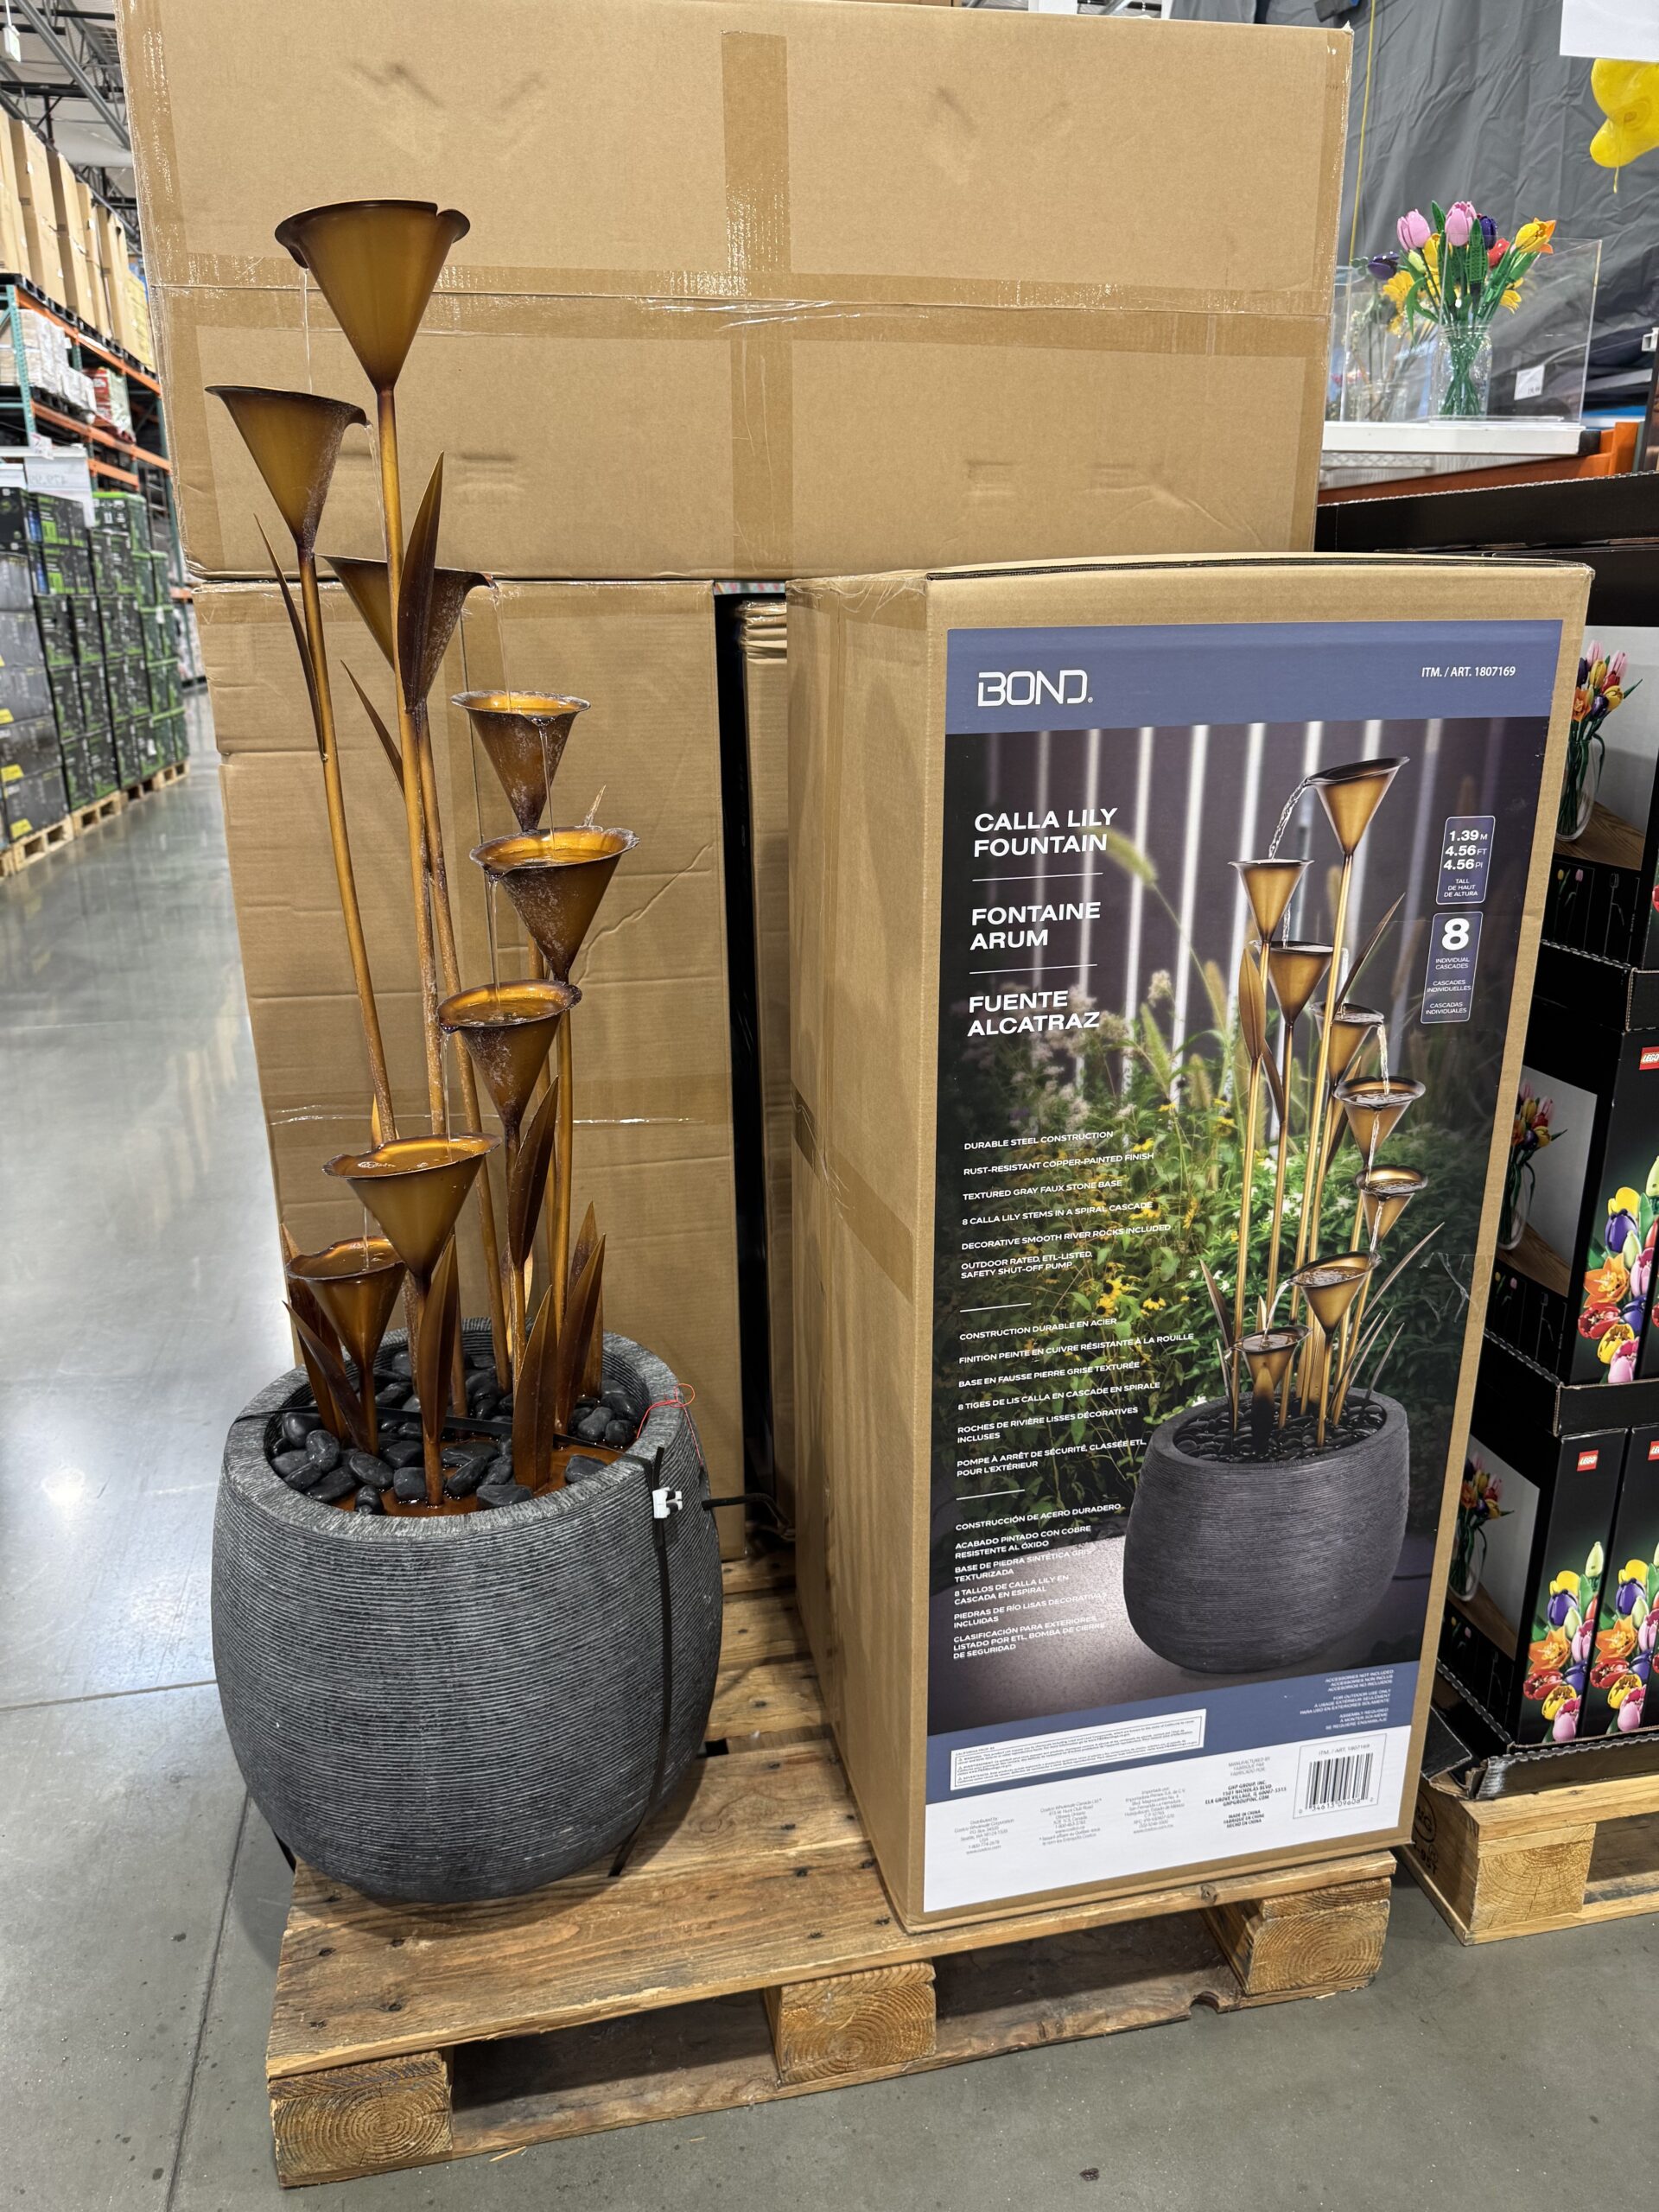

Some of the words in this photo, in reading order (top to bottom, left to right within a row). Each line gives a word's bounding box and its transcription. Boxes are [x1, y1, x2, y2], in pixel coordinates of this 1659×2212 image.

[1421, 667, 1442, 677] ITM.
[1444, 666, 1449, 677] /
[1450, 666, 1471, 677] ART.
[1475, 666, 1516, 677] 1807169
[974, 810, 1059, 832] CALLA
[1067, 807, 1118, 828] LILY
[974, 834, 1107, 858] FOUNTAIN
[1449, 830, 1478, 842] 1.39
[1445, 845, 1476, 856] 4.56
[1443, 859, 1474, 870] 4.56
[971, 901, 1101, 926] FONTAINE
[969, 929, 1048, 950] ARUM
[1441, 918, 1470, 950] 8
[969, 990, 1069, 1014] FUENTE
[967, 1011, 1100, 1037] ALCATRAZ
[964, 1140, 1009, 1150] DURABLE
[1010, 1137, 1039, 1147] STEEL
[1040, 1131, 1114, 1144] CONSTRUCTION
[963, 1162, 1041, 1176] RUST-RESISTANT
[1043, 1155, 1122, 1169] COPPER-PAINTED
[1124, 1153, 1154, 1162] FINISH
[963, 1190, 1011, 1201] TEXTURED
[1013, 1187, 1039, 1196] GRAY
[1039, 1185, 1065, 1194] FAUX
[1065, 1182, 1096, 1192] STONE
[1098, 1179, 1122, 1189] BASE
[969, 1215, 1001, 1225] CALLA
[1001, 1213, 1020, 1222] LILY
[1021, 1211, 1053, 1220] STEMS
[1074, 1206, 1108, 1216] SPIRAL
[1109, 1202, 1153, 1212] CASCADE
[962, 1237, 1020, 1249] DECORATIVE
[1021, 1234, 1062, 1244] SMOOTH
[1064, 1230, 1090, 1240] RIVER
[1092, 1228, 1124, 1237] ROCKS
[1126, 1224, 1171, 1235] INCLUDED
[961, 1258, 1008, 1270] OUTDOOR
[1009, 1255, 1040, 1266] RATED,
[961, 1268, 995, 1279] SAFETY
[997, 1264, 1044, 1275] SHUT-OFF
[1045, 1261, 1072, 1270] PUMP
[959, 1326, 1031, 1340] CONSTRUCTION
[1032, 1322, 1075, 1333] DURABLE
[1077, 1320, 1089, 1329] EN
[1090, 1318, 1116, 1327] ACIER
[959, 1353, 997, 1363] FINITION
[999, 1350, 1030, 1360] PEINTE
[1032, 1348, 1044, 1357] EN
[1046, 1344, 1078, 1355] CUIVRE
[1080, 1339, 1133, 1351] RÉSISTANTE
[1134, 1337, 1141, 1346] À
[1156, 1332, 1194, 1344] ROUILLE
[958, 1378, 982, 1388] BASE
[983, 1376, 996, 1385] EN
[998, 1373, 1032, 1383] FAUSSE
[1033, 1370, 1065, 1380] PIERRE
[1066, 1366, 1093, 1376] GRISE
[1094, 1361, 1140, 1373] TEXTURÉE
[964, 1400, 990, 1409] TIGES
[992, 1398, 1005, 1407] DE
[1006, 1396, 1020, 1405] LIS
[1020, 1393, 1051, 1403] CALLA
[1065, 1387, 1109, 1398] CASCADE
[1123, 1382, 1160, 1392] SPIRALE
[957, 1422, 995, 1433] ROCHES
[996, 1421, 1009, 1429] DE
[1010, 1416, 1045, 1427] RIVIÈRE
[1046, 1414, 1076, 1423] LISSES
[1077, 1406, 1138, 1420] DÉCORATIVES
[957, 1432, 1001, 1443] INCLUSES
[957, 1457, 989, 1467] POMPE
[991, 1454, 998, 1463] À
[999, 1451, 1029, 1462] ARRÊT
[1030, 1450, 1043, 1459] DE
[1089, 1440, 1128, 1452] CLASSÉE
[1579, 1456, 1597, 1465] LEGO
[957, 1466, 982, 1477] POUR
[956, 1514, 1025, 1530] CONSTRUCCIÓN
[1027, 1513, 1039, 1522] DE
[1040, 1510, 1070, 1520] ACERO
[1071, 1503, 1122, 1516] DURADERO
[955, 1537, 999, 1549] ACABADO
[1001, 1532, 1039, 1543] PINTADO
[1040, 1529, 1059, 1538] CON
[1061, 1525, 1091, 1535] COBRE
[955, 1545, 1007, 1559] RESISTENTE
[1007, 1543, 1020, 1552] AL
[1020, 1539, 1049, 1550] ÓXIDO
[955, 1562, 978, 1573] BASE
[979, 1560, 991, 1569] DE
[993, 1556, 1025, 1567] PIEDRA
[1027, 1550, 1070, 1563] SINTÉTICA
[954, 1567, 1014, 1583] TEXTURIZADA
[961, 1584, 994, 1595] TALLOS
[995, 1582, 1007, 1591] DE
[1008, 1579, 1037, 1589] CALLA
[1038, 1576, 1055, 1585] LILY
[954, 1592, 996, 1605] CASCADA
[998, 1590, 1009, 1599] EN
[1011, 1586, 1046, 1597] ESPIRAL
[954, 1607, 991, 1619] PIEDRAS
[992, 1605, 1005, 1614] DE
[1006, 1603, 1021, 1612] RÍO
[1022, 1600, 1046, 1611] LISAS
[954, 1615, 999, 1628] INCLUIDAS
[953, 1625, 1018, 1643] CLASIFICACIÓN
[1020, 1623, 1043, 1633] PARA
[953, 1638, 989, 1650] LISTADO
[990, 1636, 1009, 1645] POR
[1028, 1628, 1060, 1640] BOMBA
[1062, 1626, 1074, 1635] DE
[953, 1650, 965, 1659] DE
[966, 1643, 1017, 1657] SEGURIDAD
